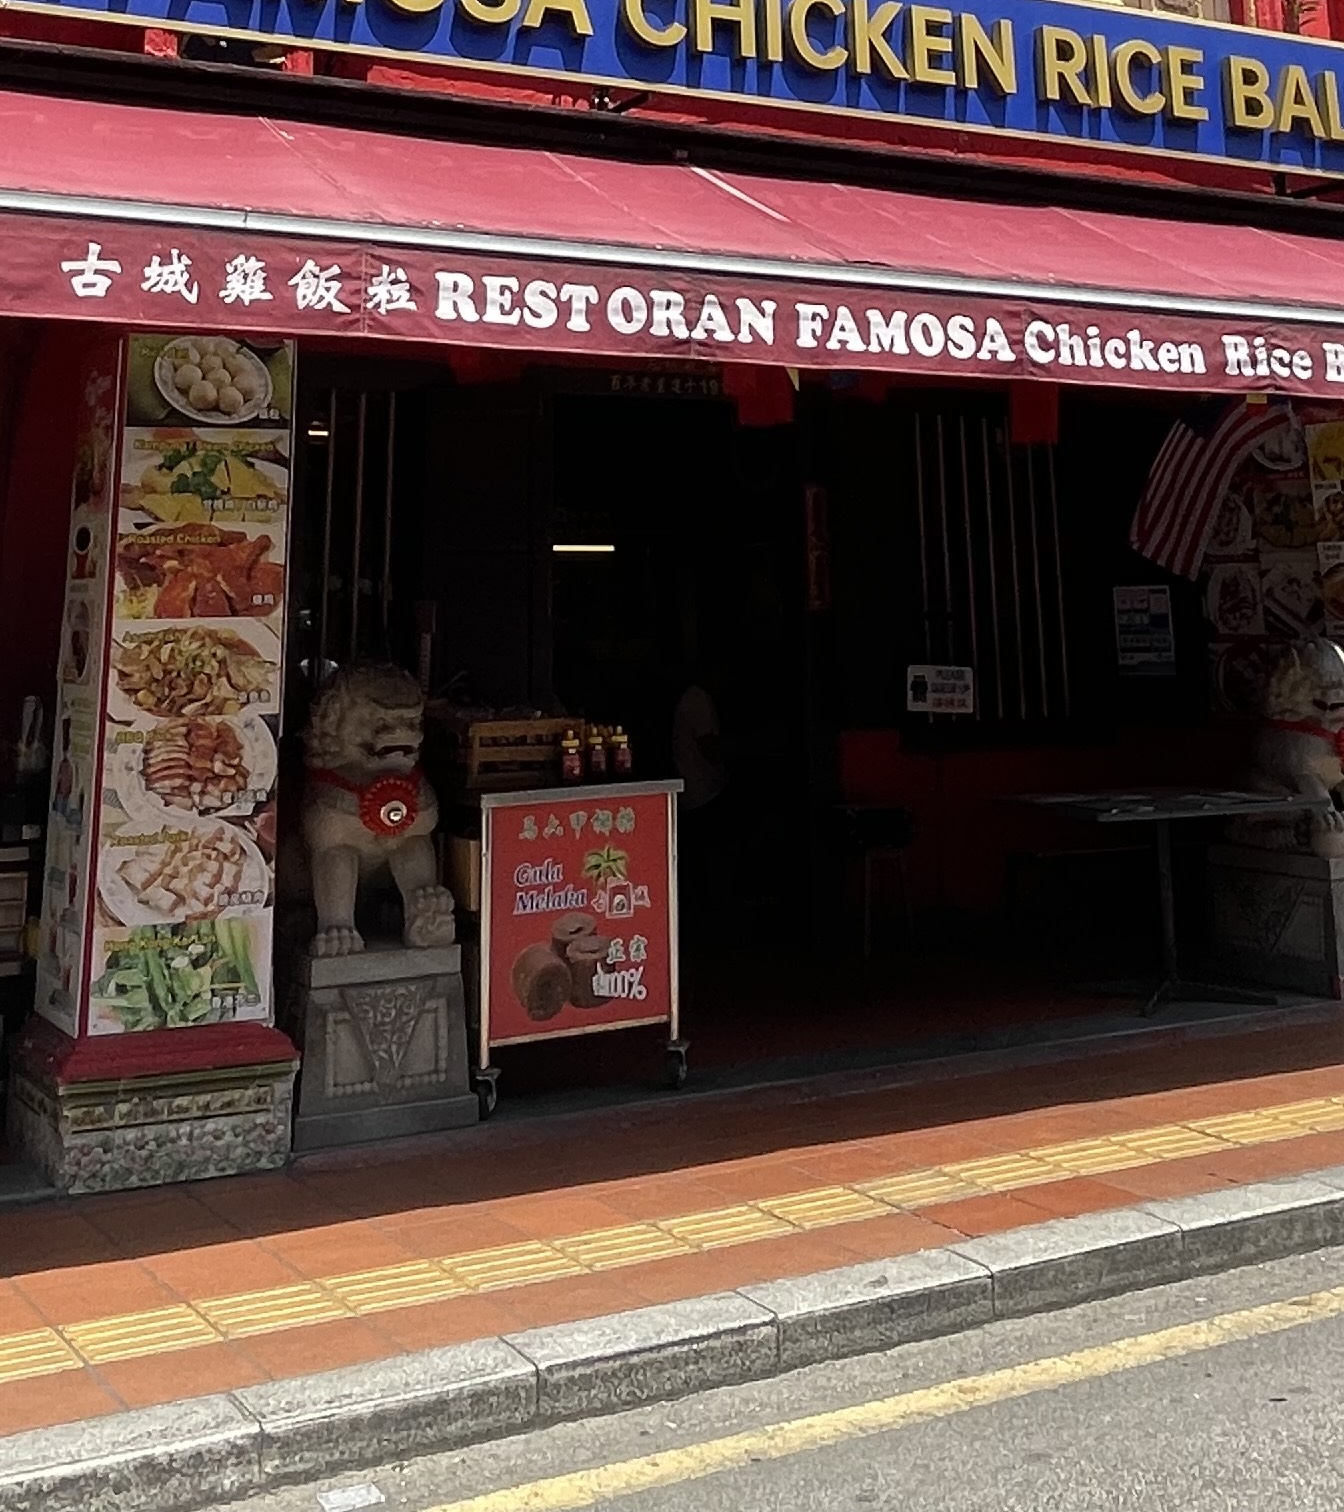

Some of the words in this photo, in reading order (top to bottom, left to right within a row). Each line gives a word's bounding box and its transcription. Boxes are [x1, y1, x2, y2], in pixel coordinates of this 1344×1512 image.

[1042, 25, 1209, 121] RICE
[435, 270, 777, 346] RESTORAN
[795, 302, 1017, 364] FAMOSA
[1023, 320, 1208, 375] Chicken
[1222, 334, 1314, 381] Rice
